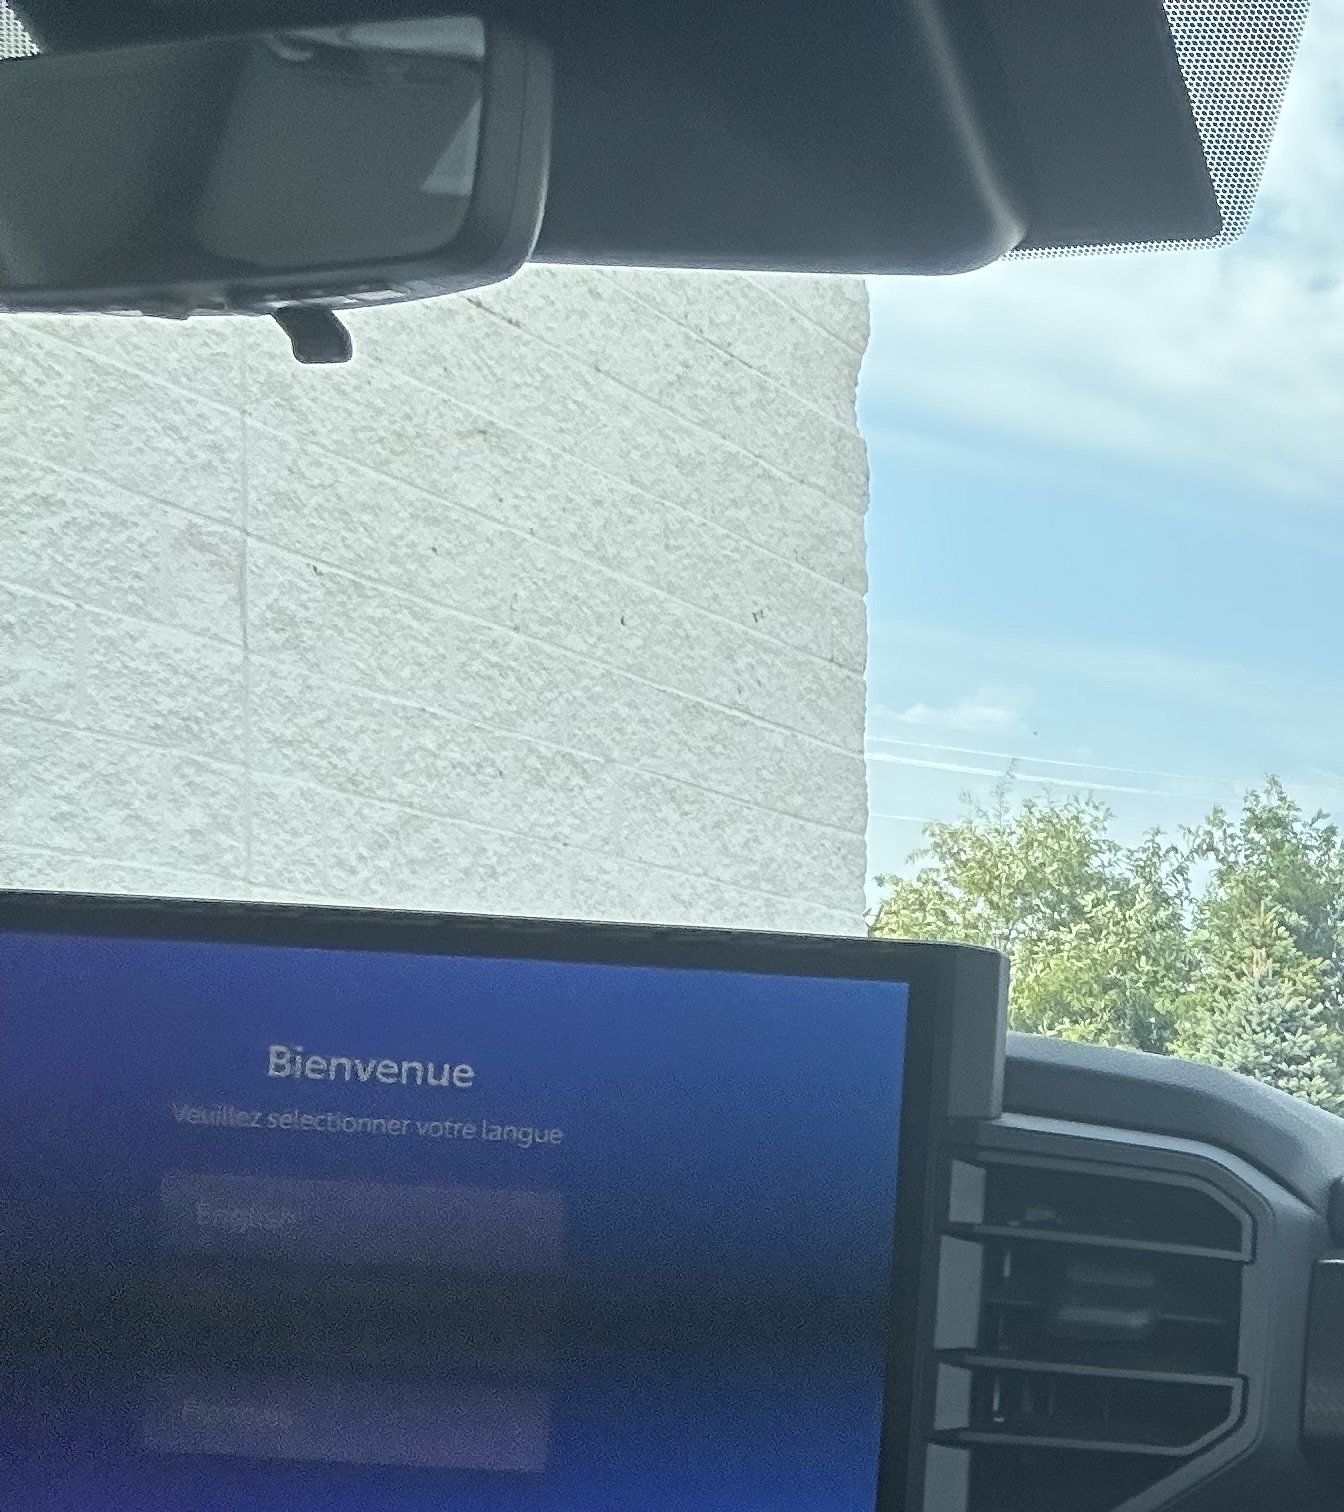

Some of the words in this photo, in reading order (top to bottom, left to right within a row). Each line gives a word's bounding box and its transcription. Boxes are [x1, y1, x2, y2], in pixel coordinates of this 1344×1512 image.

[267, 1044, 477, 1089] Bienvenue
[171, 1101, 262, 1129] Veuillez
[415, 1114, 477, 1140] votre
[481, 1120, 565, 1149] langue
